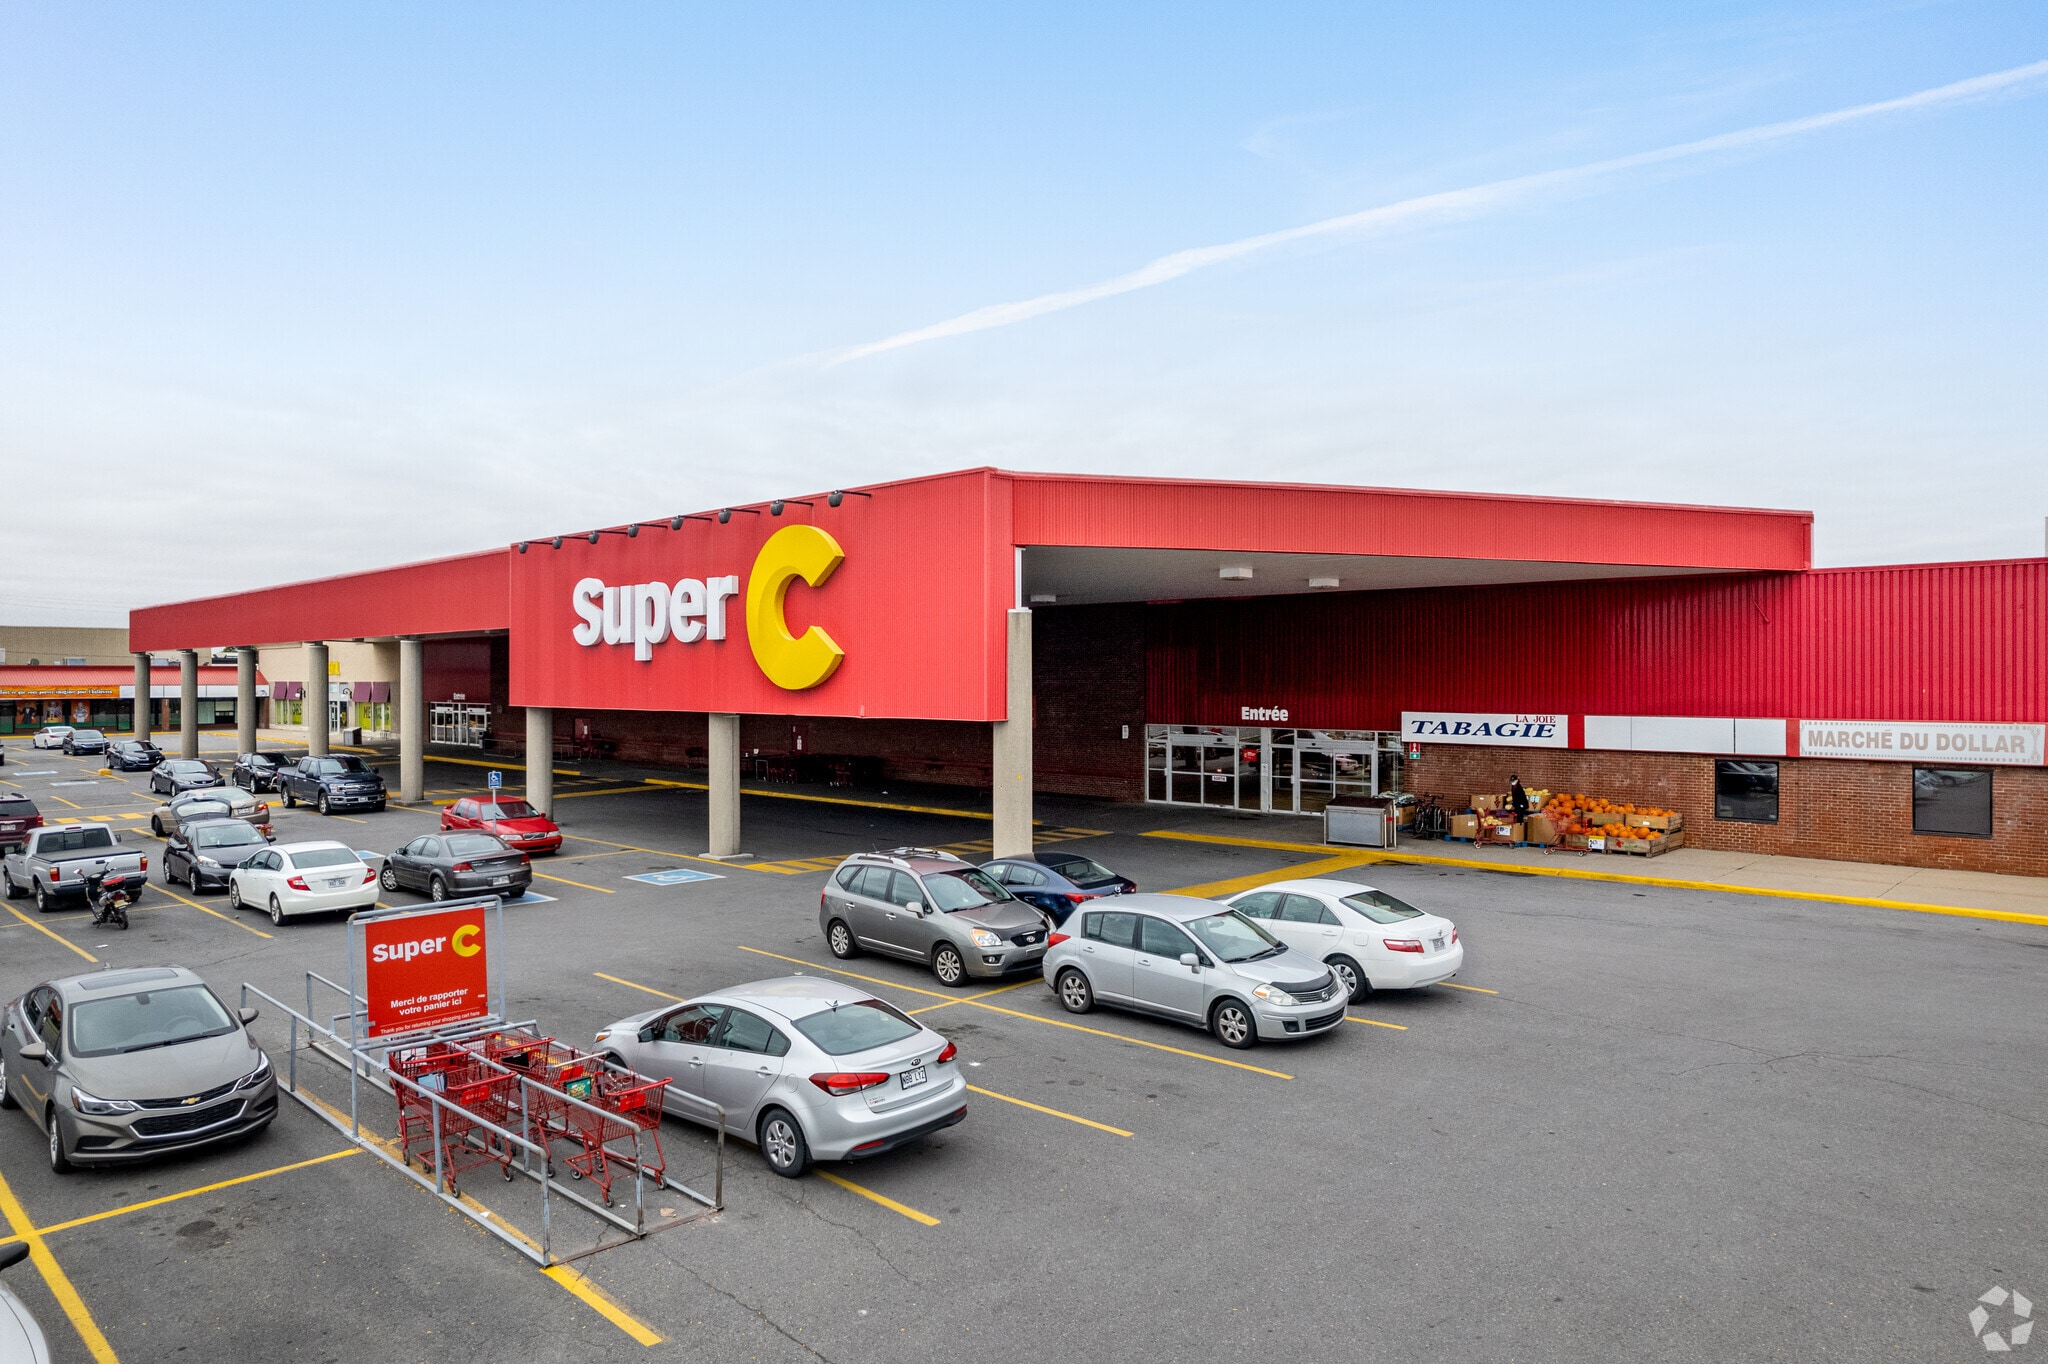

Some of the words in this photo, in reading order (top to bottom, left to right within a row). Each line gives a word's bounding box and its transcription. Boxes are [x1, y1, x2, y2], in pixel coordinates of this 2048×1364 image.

[746, 524, 845, 690] C
[1241, 705, 1289, 722] Entrée
[1515, 714, 1529, 723] LA
[1533, 715, 1556, 724] JOIE
[1411, 720, 1556, 738] TABAGIE
[1808, 729, 1893, 749] MARCHÉ
[1900, 732, 1929, 751] DU
[1936, 733, 2026, 754] DOLLAR
[372, 936, 447, 963] Super
[451, 924, 481, 958] C
[390, 997, 414, 1008] Merci
[416, 995, 427, 1004] de
[429, 988, 468, 1001] rapporter
[399, 1006, 421, 1016] votre
[423, 1000, 450, 1013] panier
[452, 997, 462, 1006] ici
[380, 1027, 395, 1035] Thank
[411, 1020, 431, 1029] returning
[441, 1014, 461, 1024] shopping
